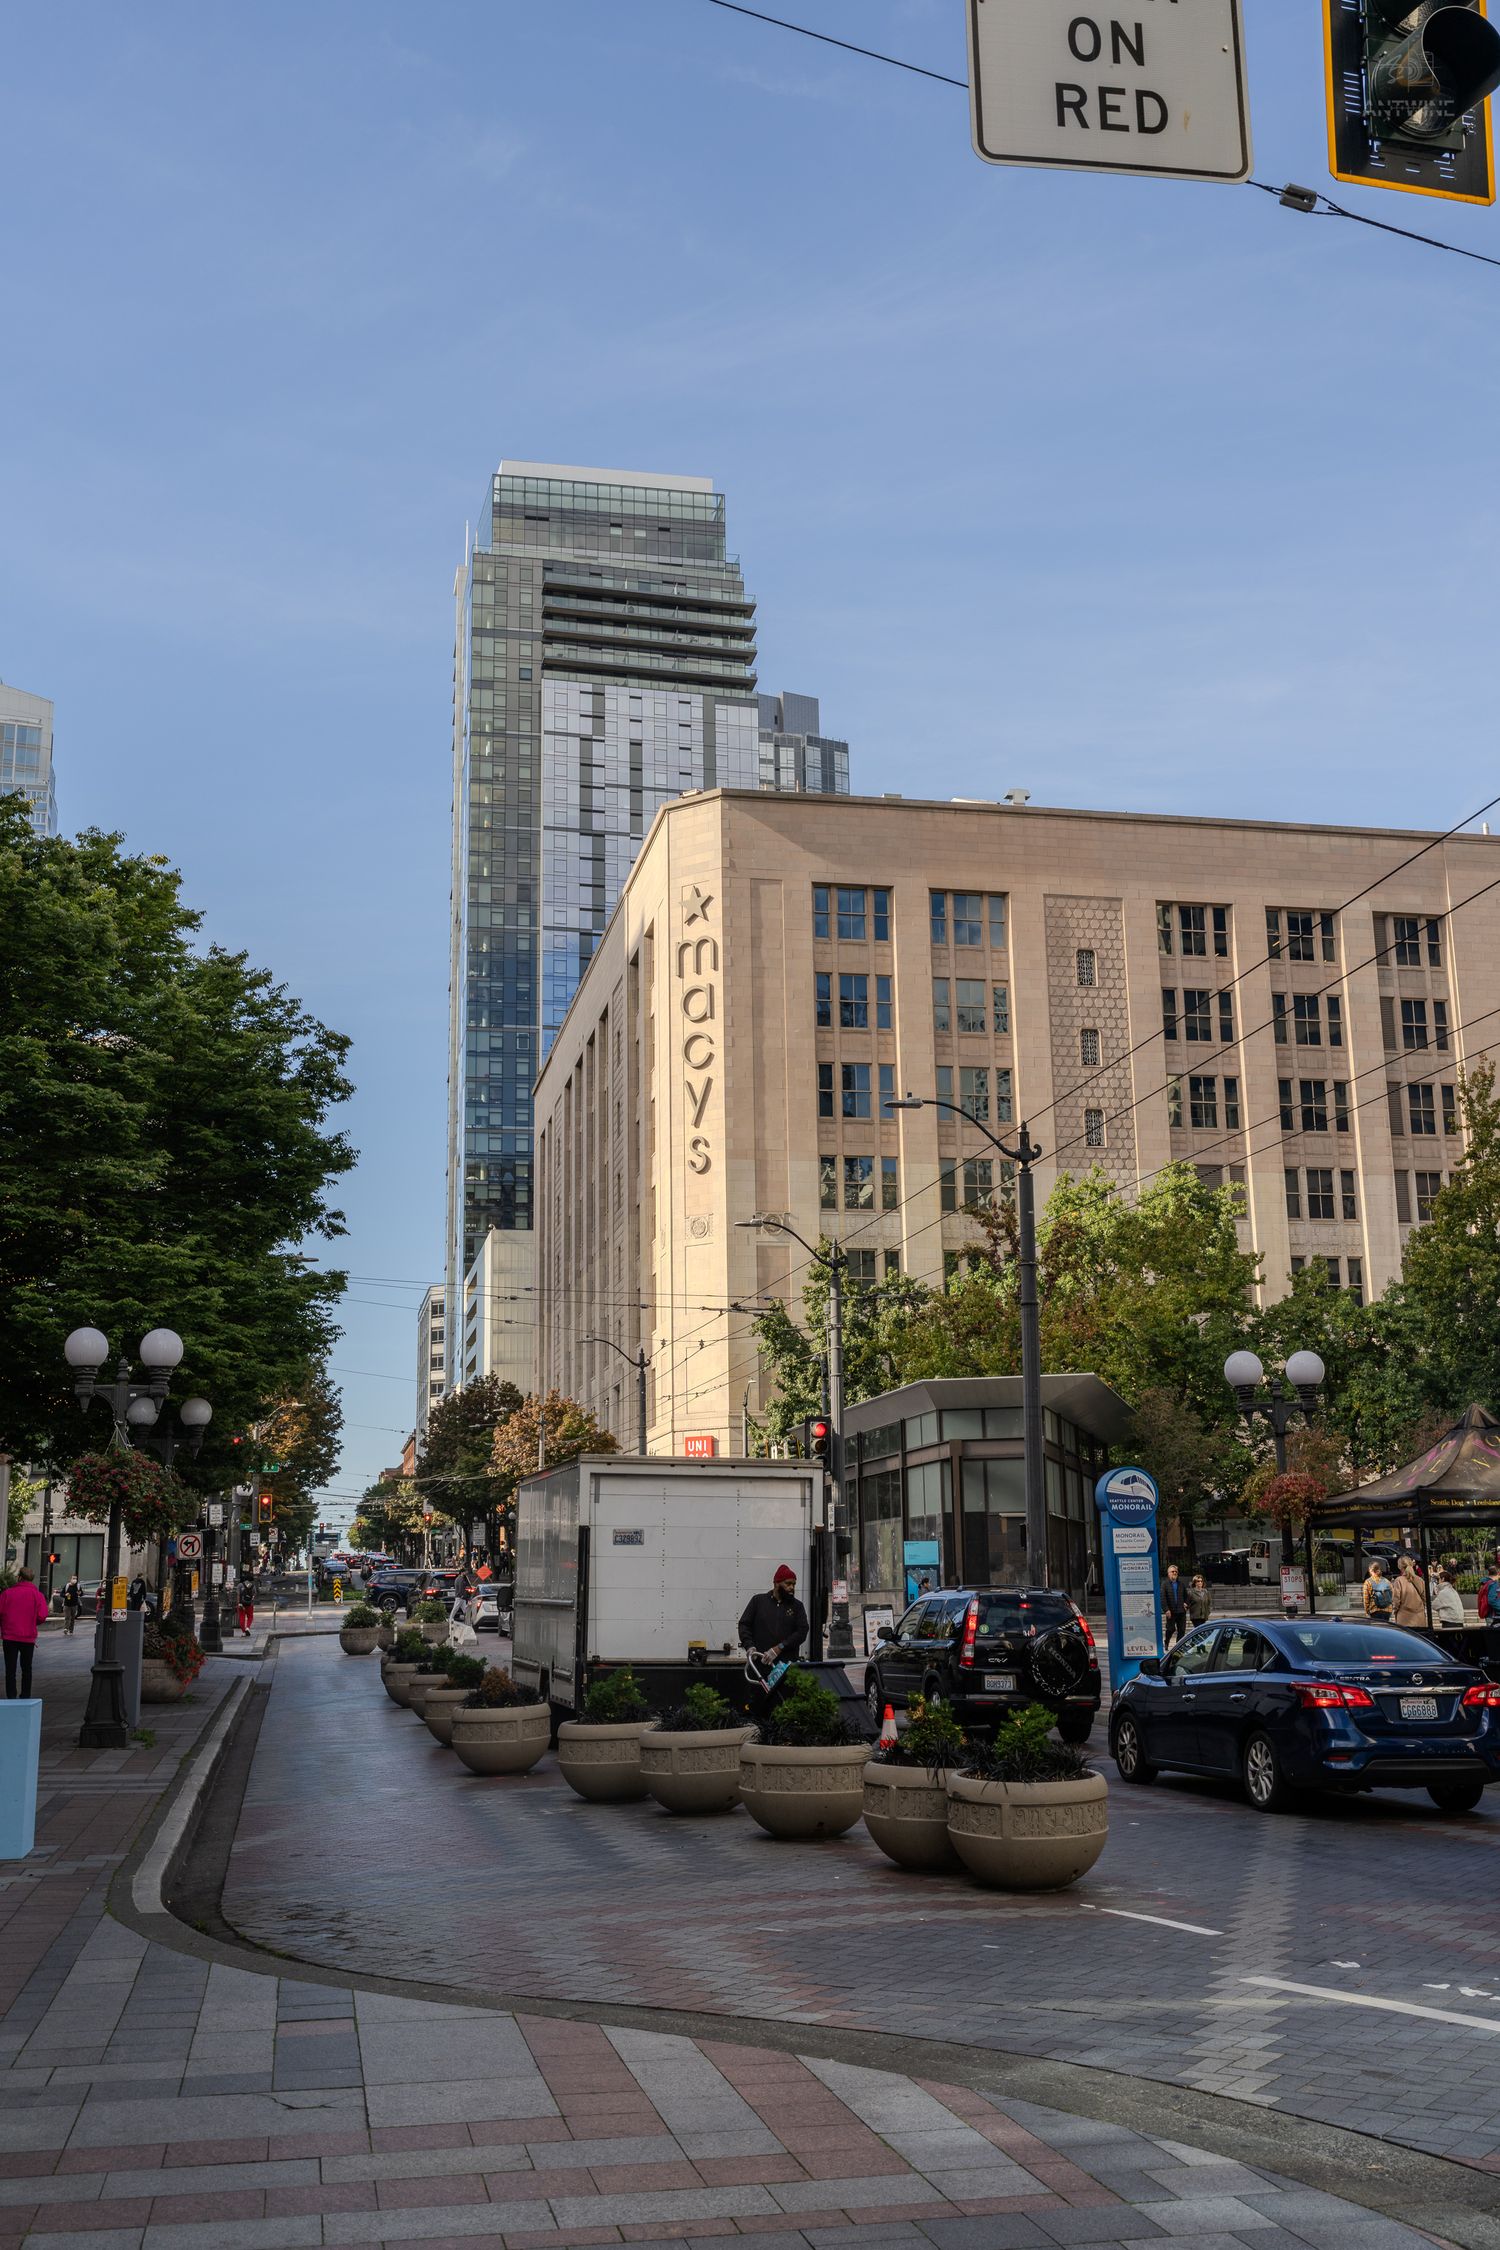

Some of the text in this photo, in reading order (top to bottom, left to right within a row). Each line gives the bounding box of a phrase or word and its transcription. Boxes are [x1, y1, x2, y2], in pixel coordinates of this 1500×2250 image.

[1067, 16, 1145, 67] ON
[1055, 82, 1168, 134] RED
[677, 934, 719, 1175] macys
[687, 1440, 707, 1452] UNI
[1111, 1503, 1153, 1511] MONORAIL
[1430, 1498, 1450, 1506] Seattle
[1451, 1499, 1464, 1507] Dog
[1048, 1646, 1077, 1679] HONDA
